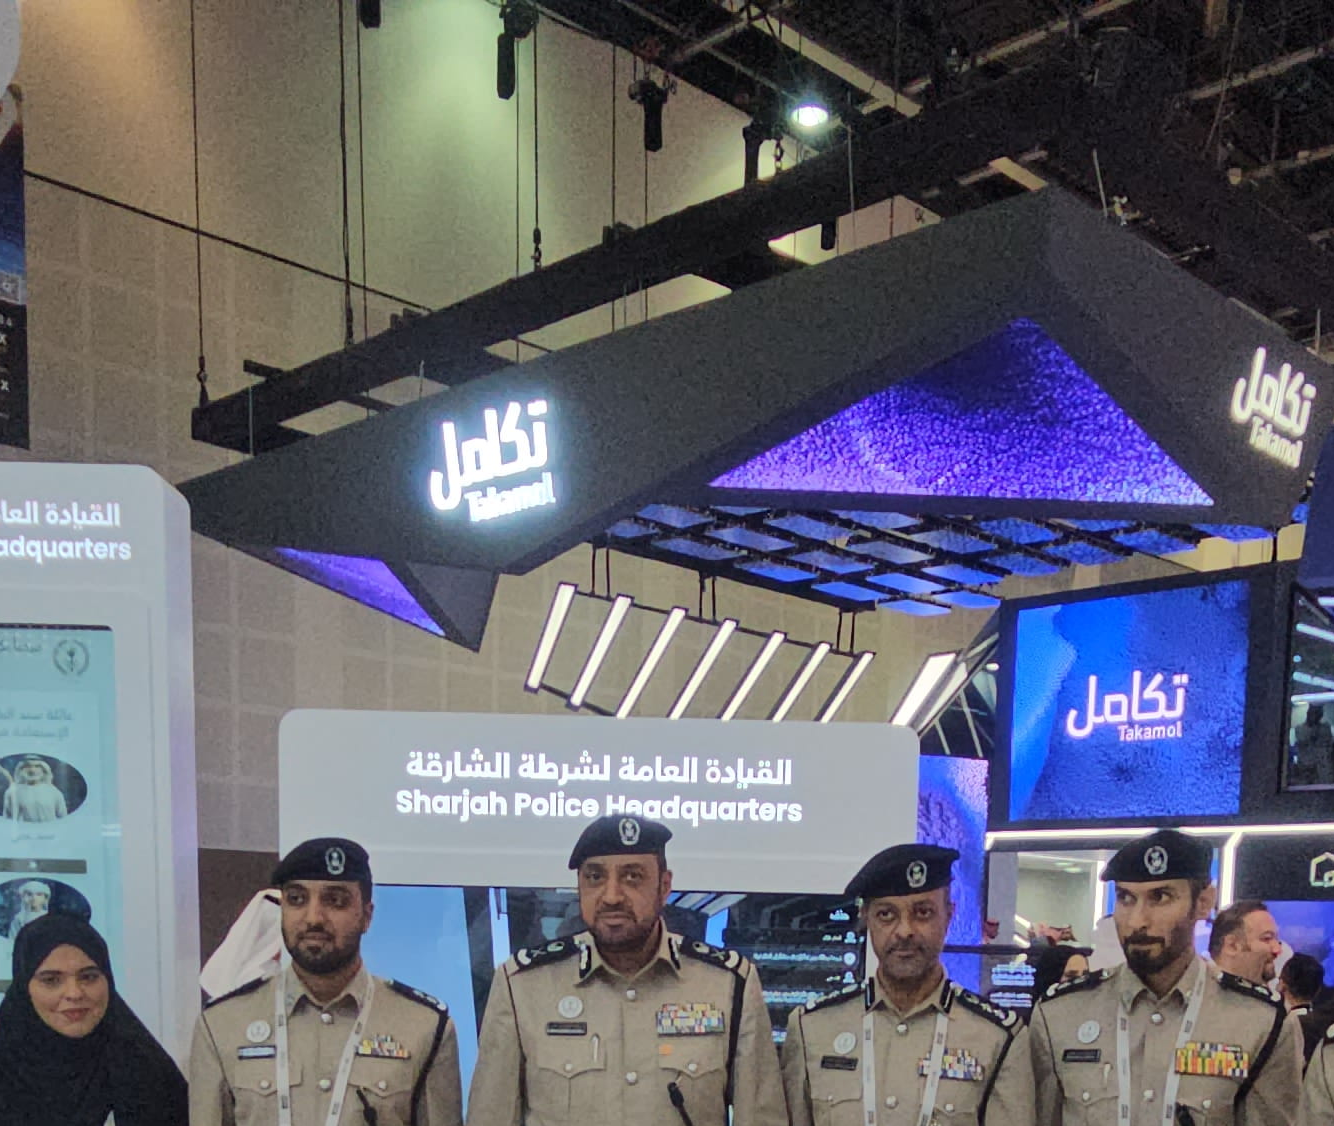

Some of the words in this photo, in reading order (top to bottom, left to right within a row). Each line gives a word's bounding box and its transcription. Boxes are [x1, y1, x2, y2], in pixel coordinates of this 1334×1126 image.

[1230, 346, 1317, 437] تكامل
[430, 400, 548, 510] تكامل
[45, 502, 121, 531] القيادة
[1067, 670, 1189, 739] تكامل
[1118, 721, 1182, 742] Takamol
[405, 748, 511, 784] الشارقة
[517, 750, 611, 786] لشرطة
[618, 756, 698, 784] العامة
[705, 758, 793, 790] القيادة
[396, 788, 508, 822] Sharjah
[514, 791, 599, 818] Police
[606, 794, 803, 827] Headquarters
